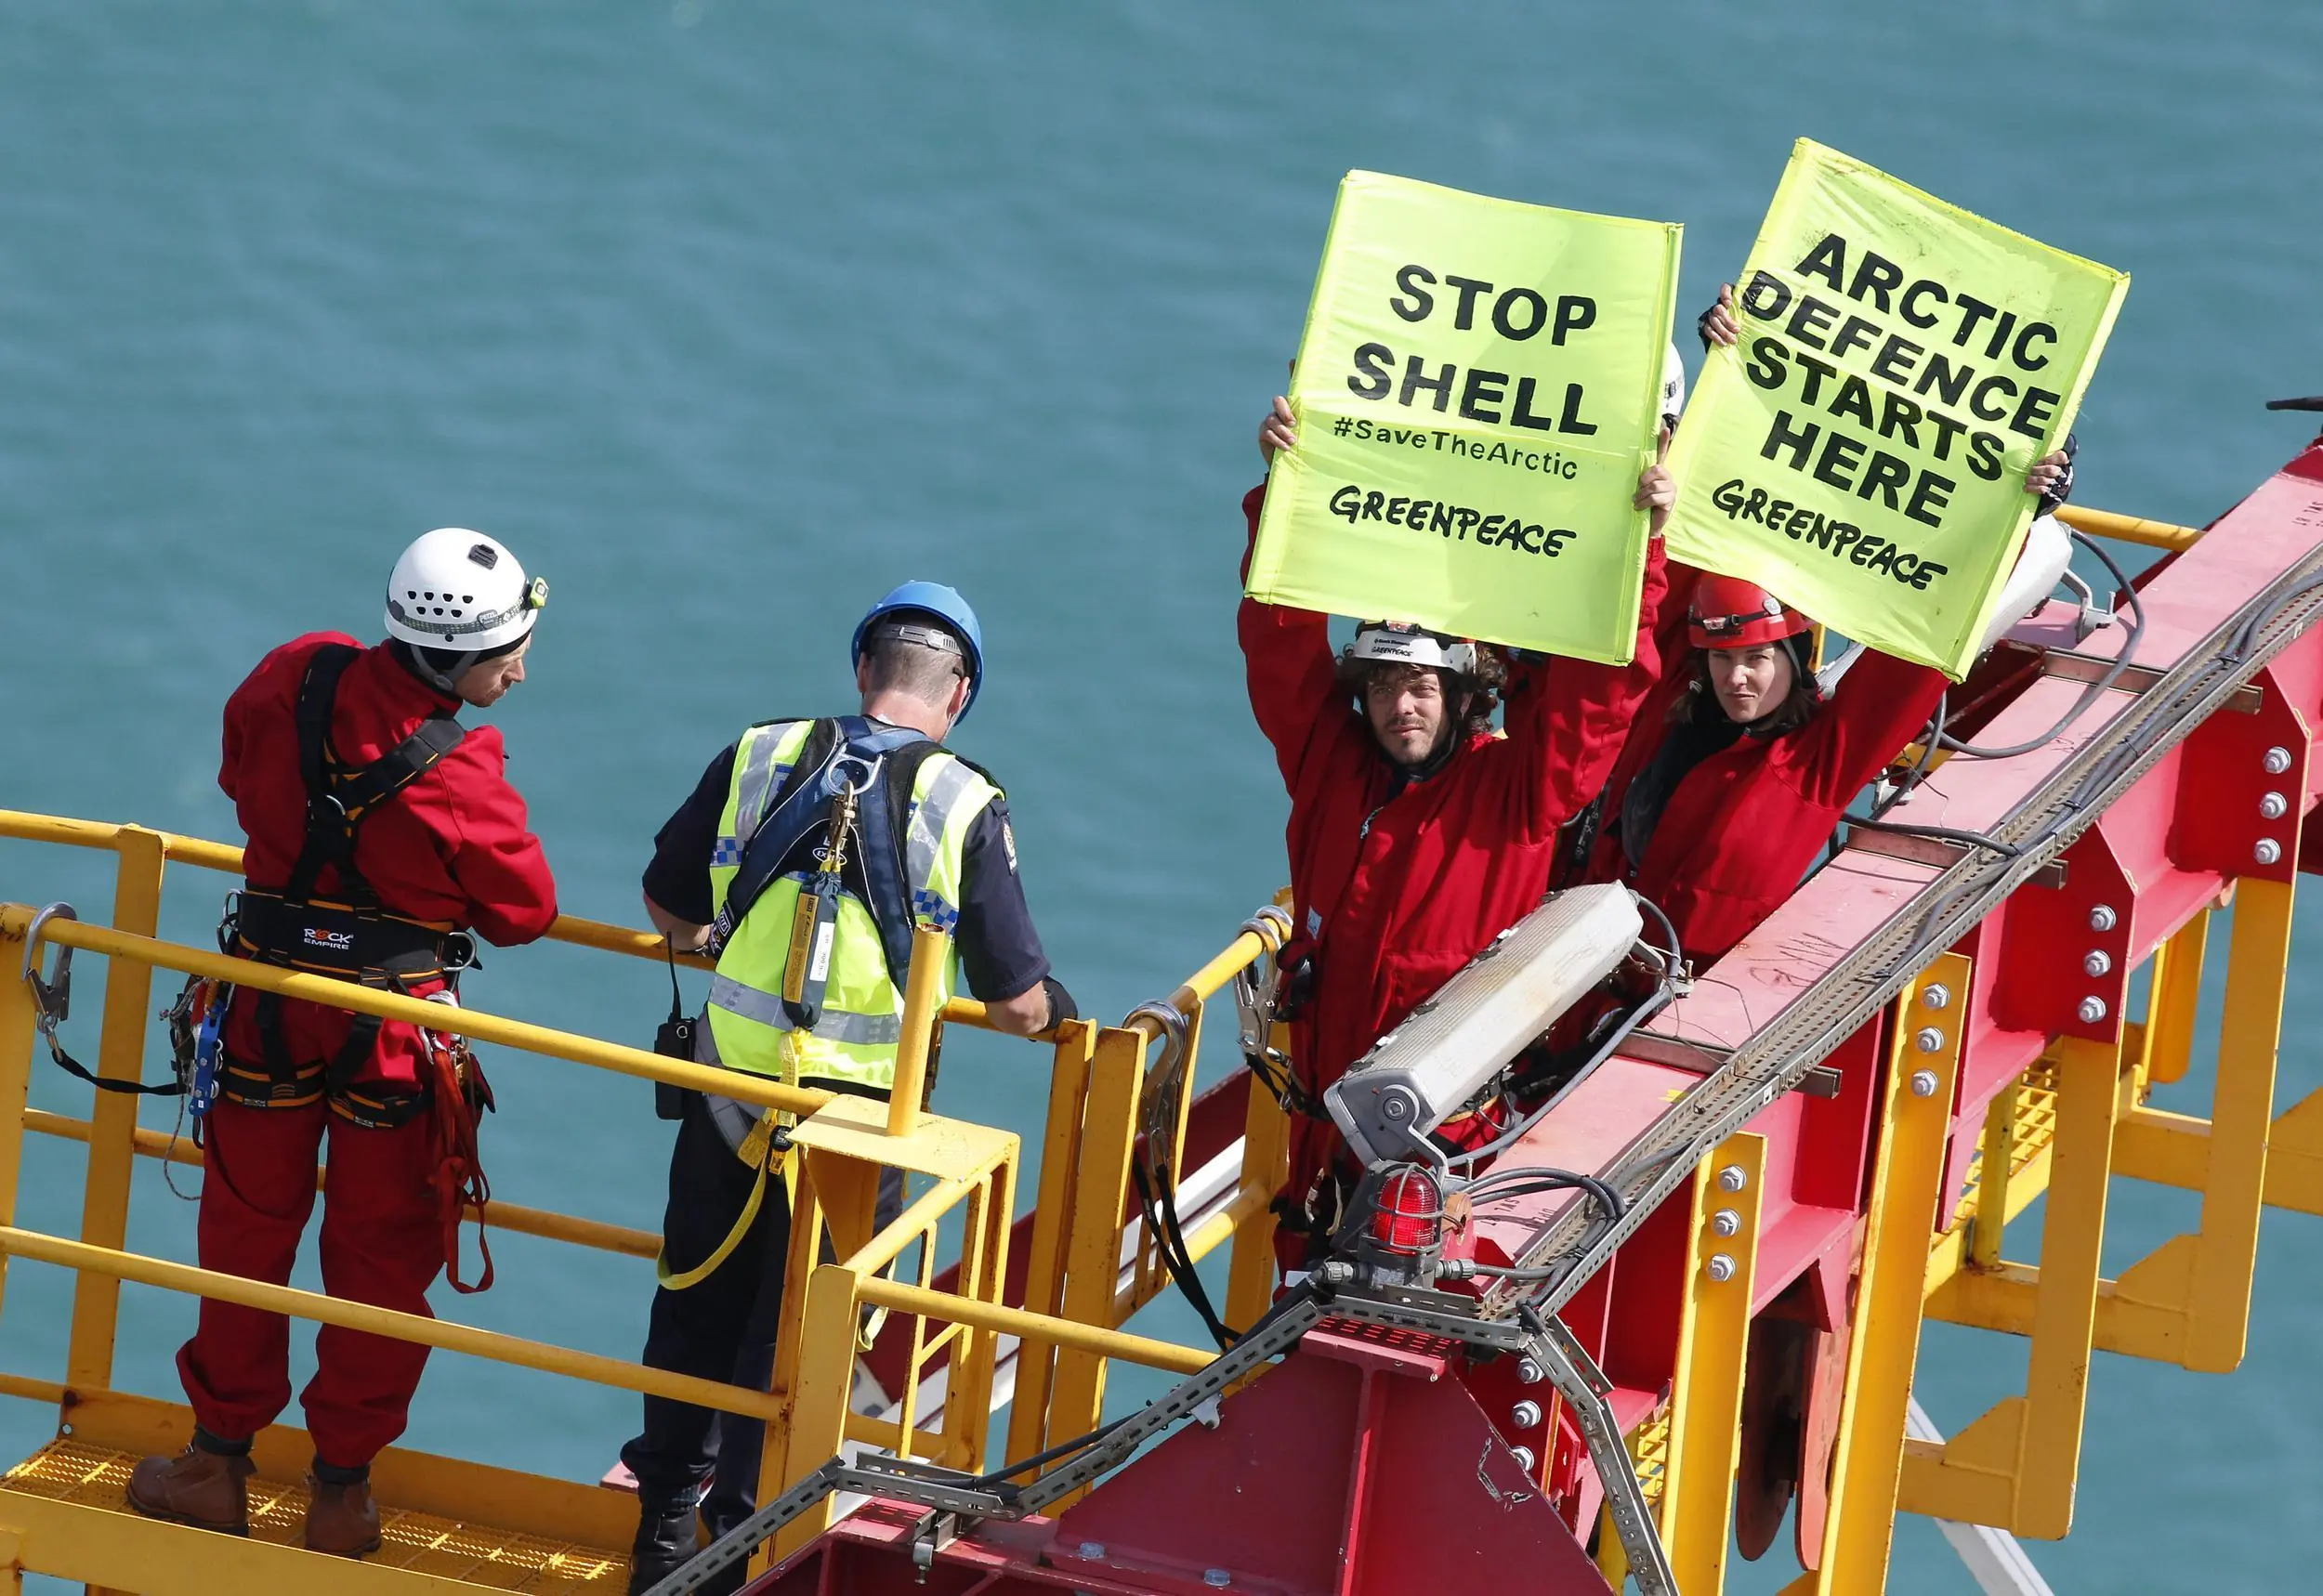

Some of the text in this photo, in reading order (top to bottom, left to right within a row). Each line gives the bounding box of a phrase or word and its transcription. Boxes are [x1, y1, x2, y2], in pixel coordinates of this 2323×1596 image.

[1389, 264, 1597, 347] STOP
[1794, 233, 2057, 372] ARCTIC
[1347, 342, 1598, 436] SHELL
[1740, 269, 2061, 441] DEFENCE
[1333, 416, 1578, 480] #SaveTheArctic
[1746, 336, 2005, 481] STARTS
[1760, 409, 1957, 529] HERE
[1329, 485, 1578, 558] GREENPEACE
[1712, 478, 1949, 591] GREENPEACE
[304, 928, 352, 944] ROCK
[304, 937, 349, 950] EMPIRE
